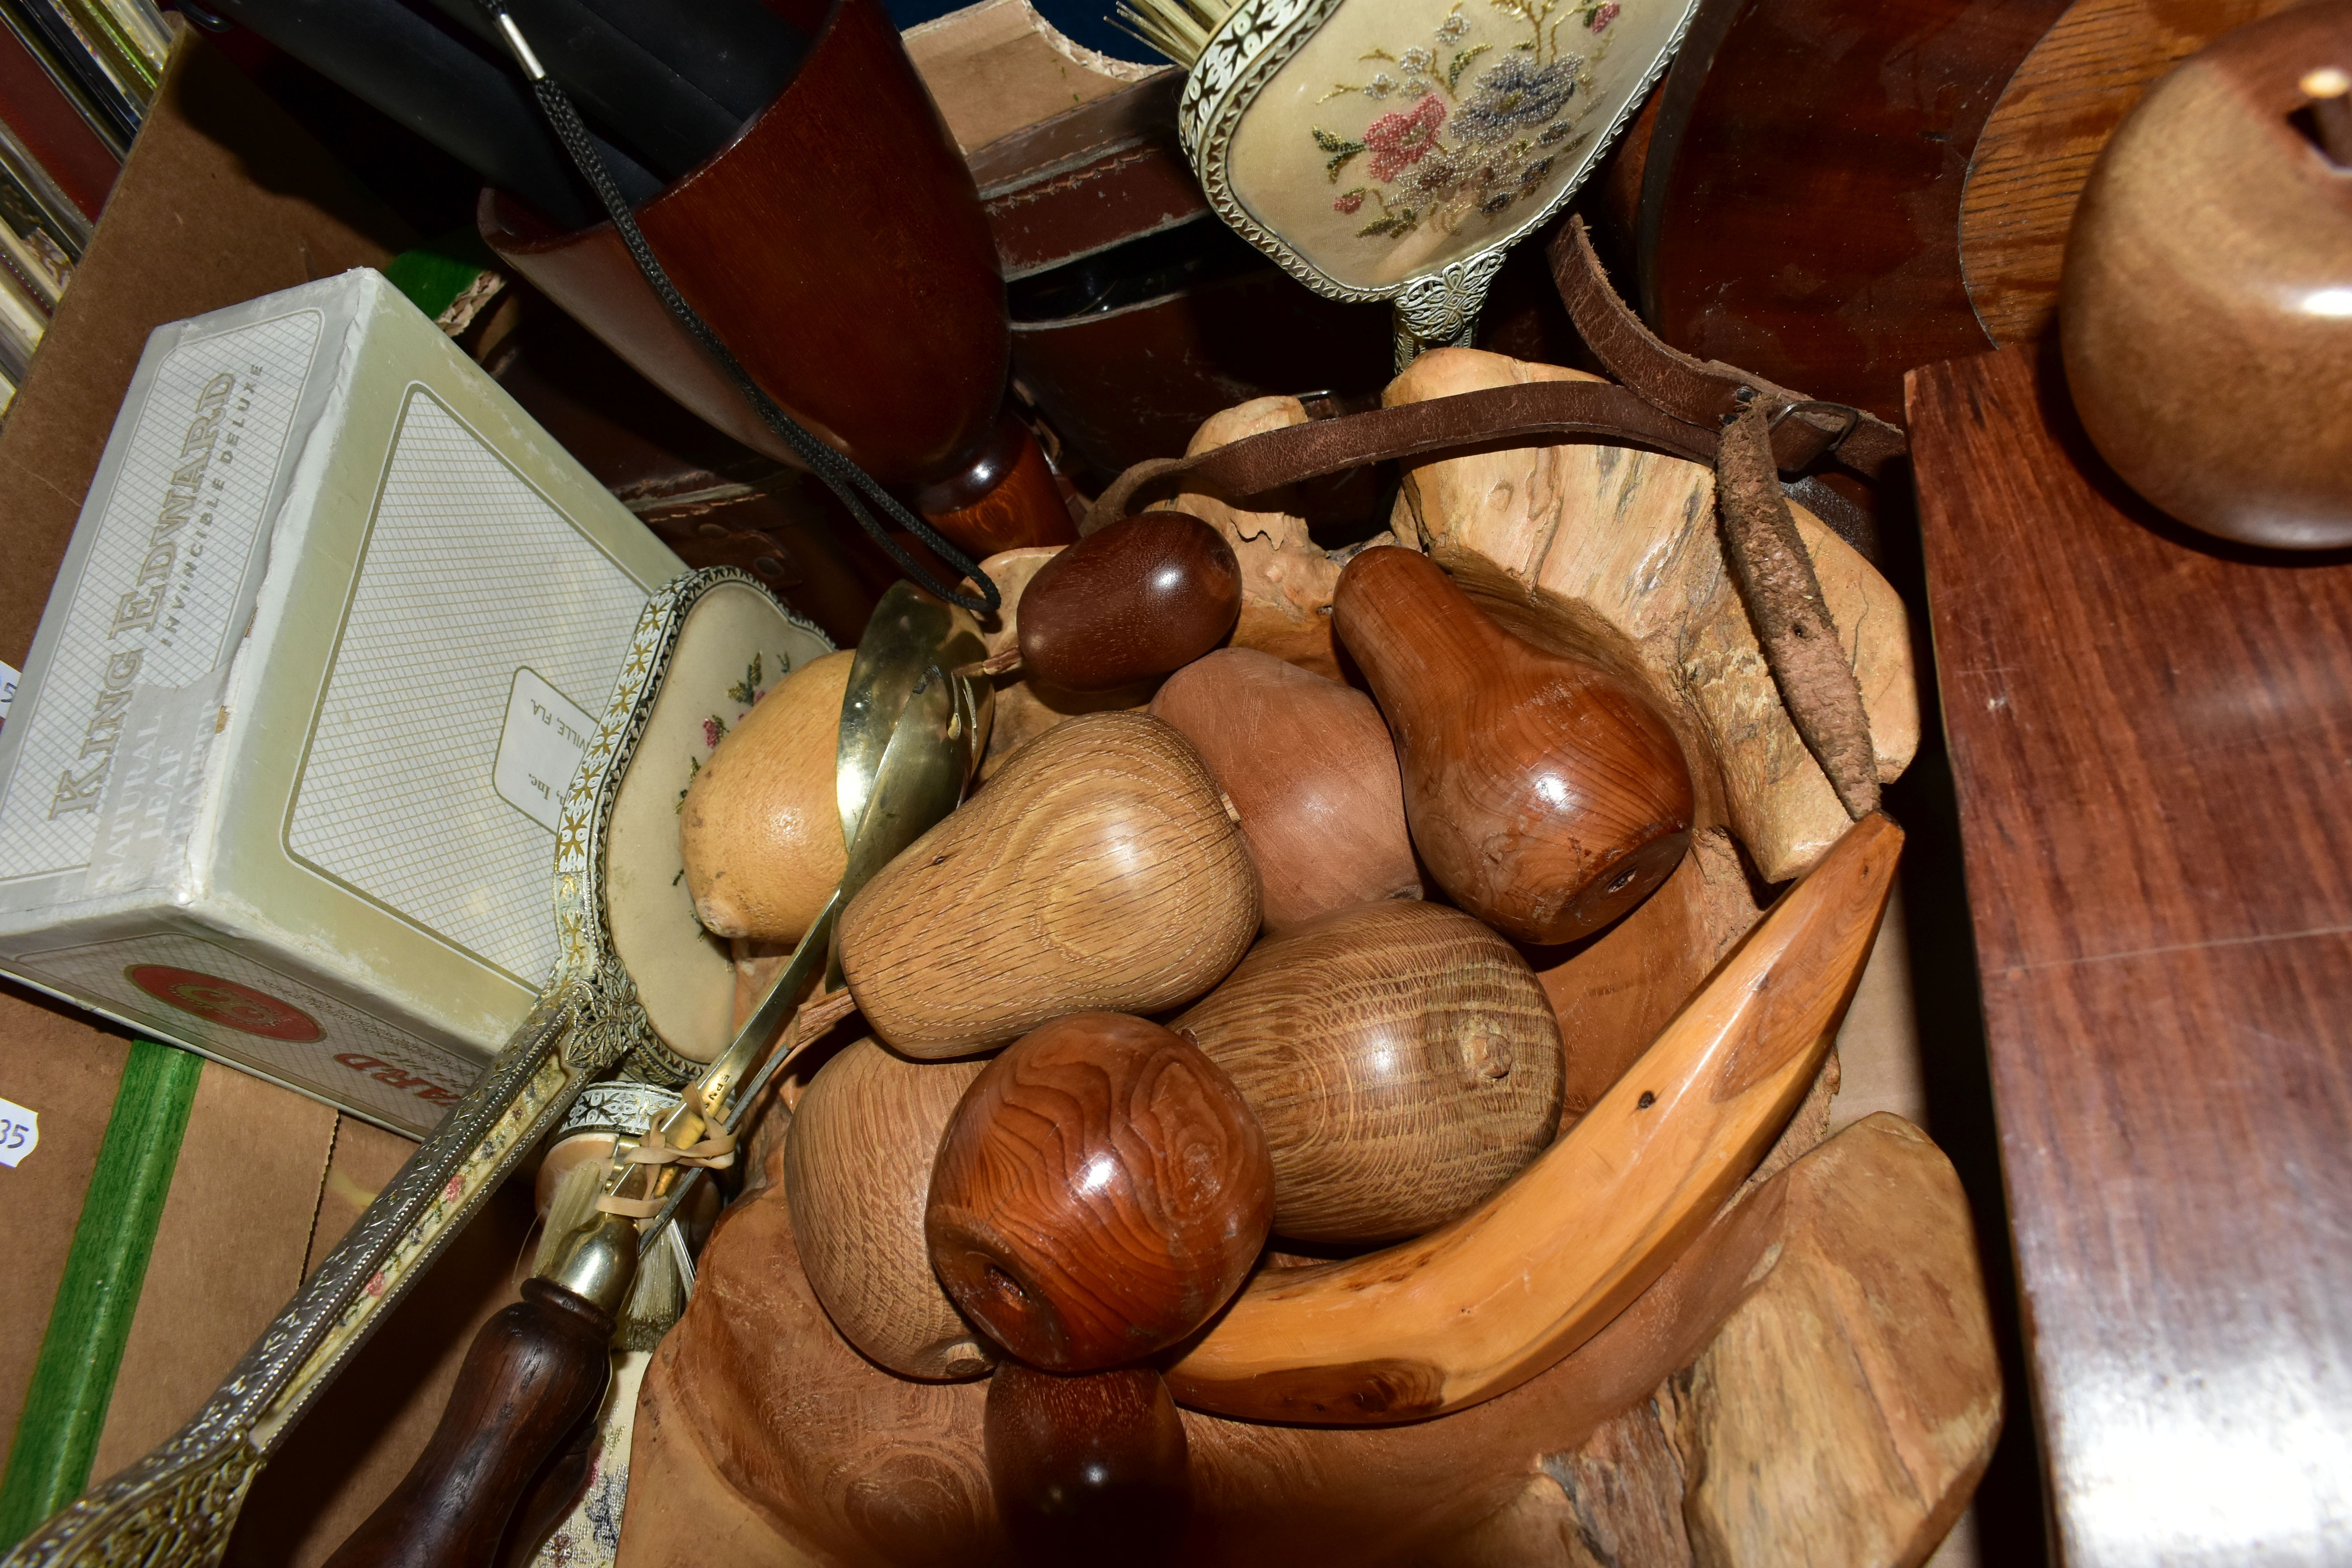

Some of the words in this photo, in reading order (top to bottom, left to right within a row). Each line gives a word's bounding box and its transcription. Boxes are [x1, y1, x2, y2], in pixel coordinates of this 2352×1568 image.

[161, 477, 225, 648] INVINCIBLE
[220, 364, 263, 465] DELUXE
[47, 647, 148, 821] KING
[107, 371, 236, 640] EDWARD
[531, 699, 552, 726] FLA.
[557, 717, 590, 753] VILLE,
[95, 714, 162, 889] NATURAL
[139, 744, 182, 841] LEAF
[528, 773, 550, 800] Inc.
[257, 979, 302, 999] TOBACCO
[0, 1119, 29, 1149] 35
